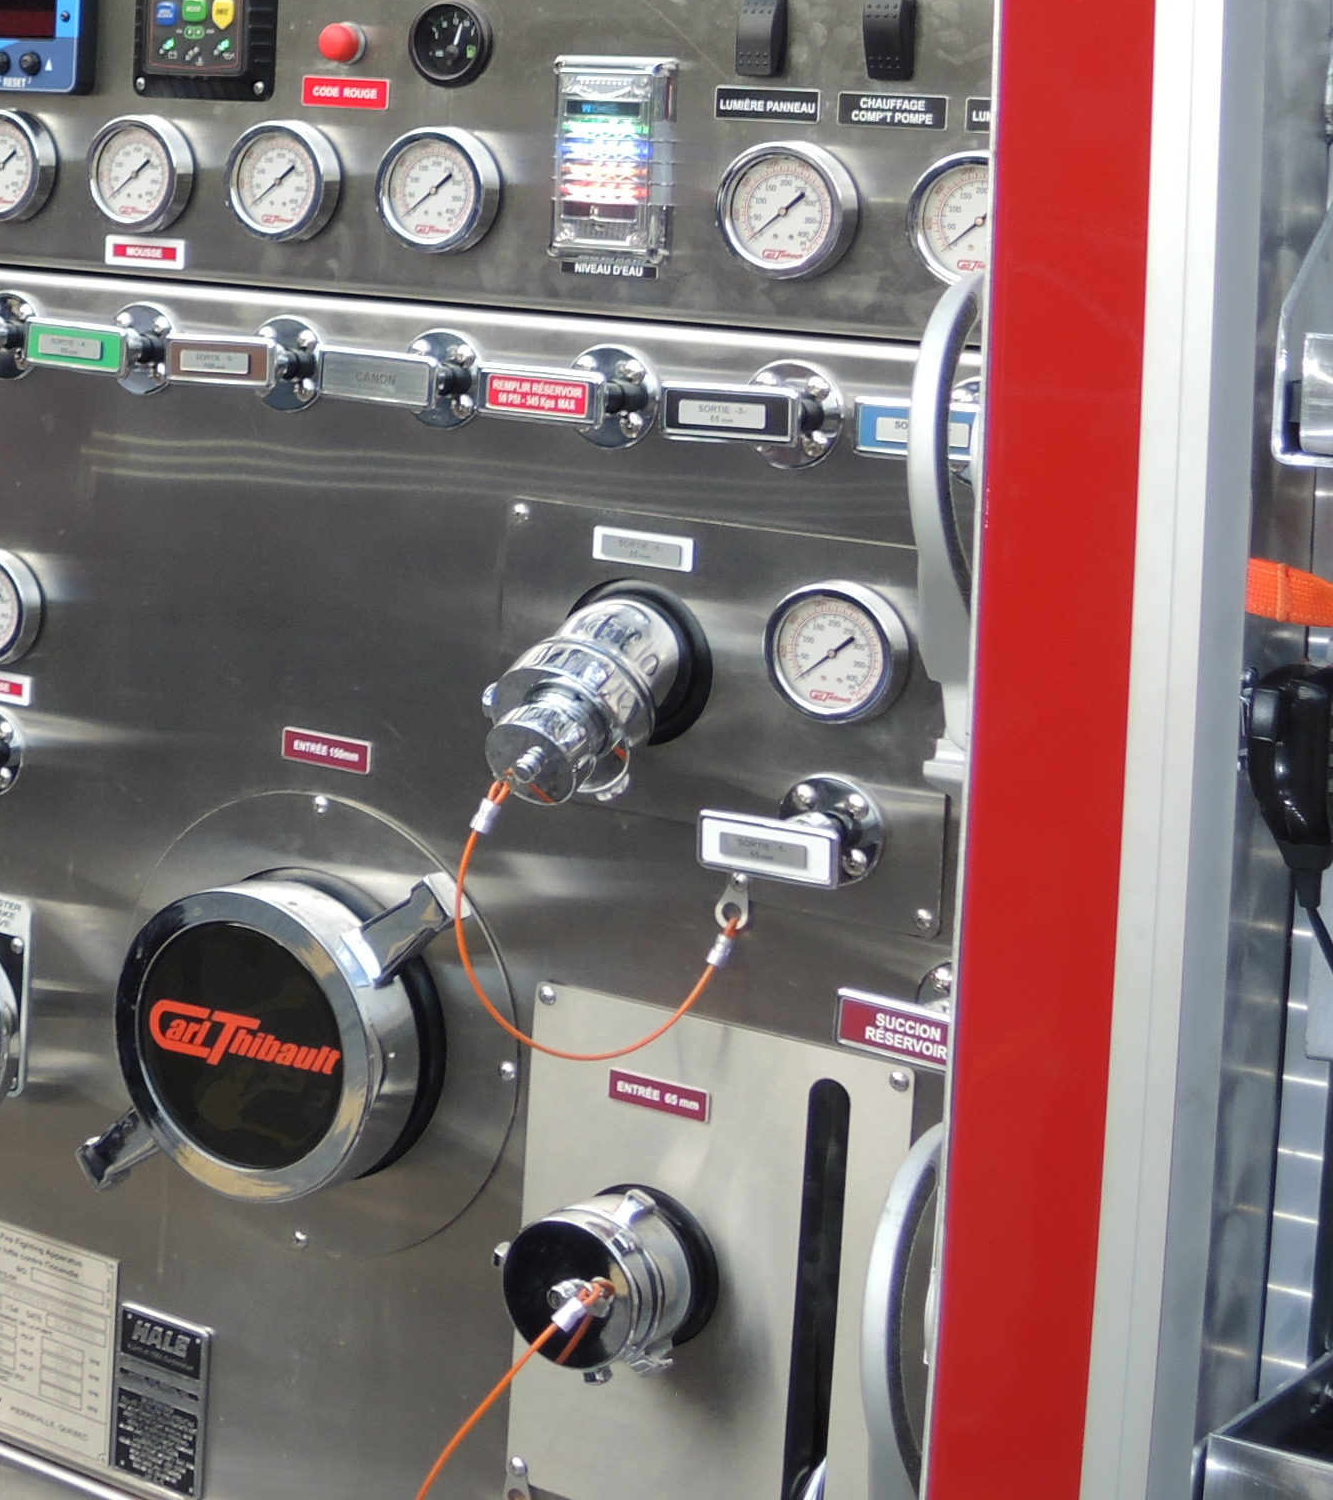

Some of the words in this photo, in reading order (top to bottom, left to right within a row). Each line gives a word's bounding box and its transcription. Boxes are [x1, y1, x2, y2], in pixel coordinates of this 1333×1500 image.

[2, 76, 27, 88] RESET
[313, 85, 339, 97] CODE
[343, 87, 377, 99] ROUGE
[766, 100, 815, 114] PANNEAU
[860, 97, 925, 111] CHAUFFAGE
[894, 111, 933, 124] POMPE
[125, 246, 162, 258] MOUSSE
[575, 263, 611, 275] NIVEAU
[612, 264, 643, 276] D'EAU
[355, 371, 396, 386] CANON
[492, 379, 530, 393] REMPLIR
[531, 381, 583, 398] RÉSERVOIR
[558, 400, 575, 411] MAX
[293, 739, 328, 757] ENTRÉE
[875, 1012, 941, 1041] SUCCION
[149, 999, 215, 1059] Carl
[207, 1012, 341, 1075] Thibault
[865, 1025, 948, 1059] RÉSERVOIR
[616, 1079, 660, 1100] ENTRÉE
[132, 1320, 192, 1359] HALE
